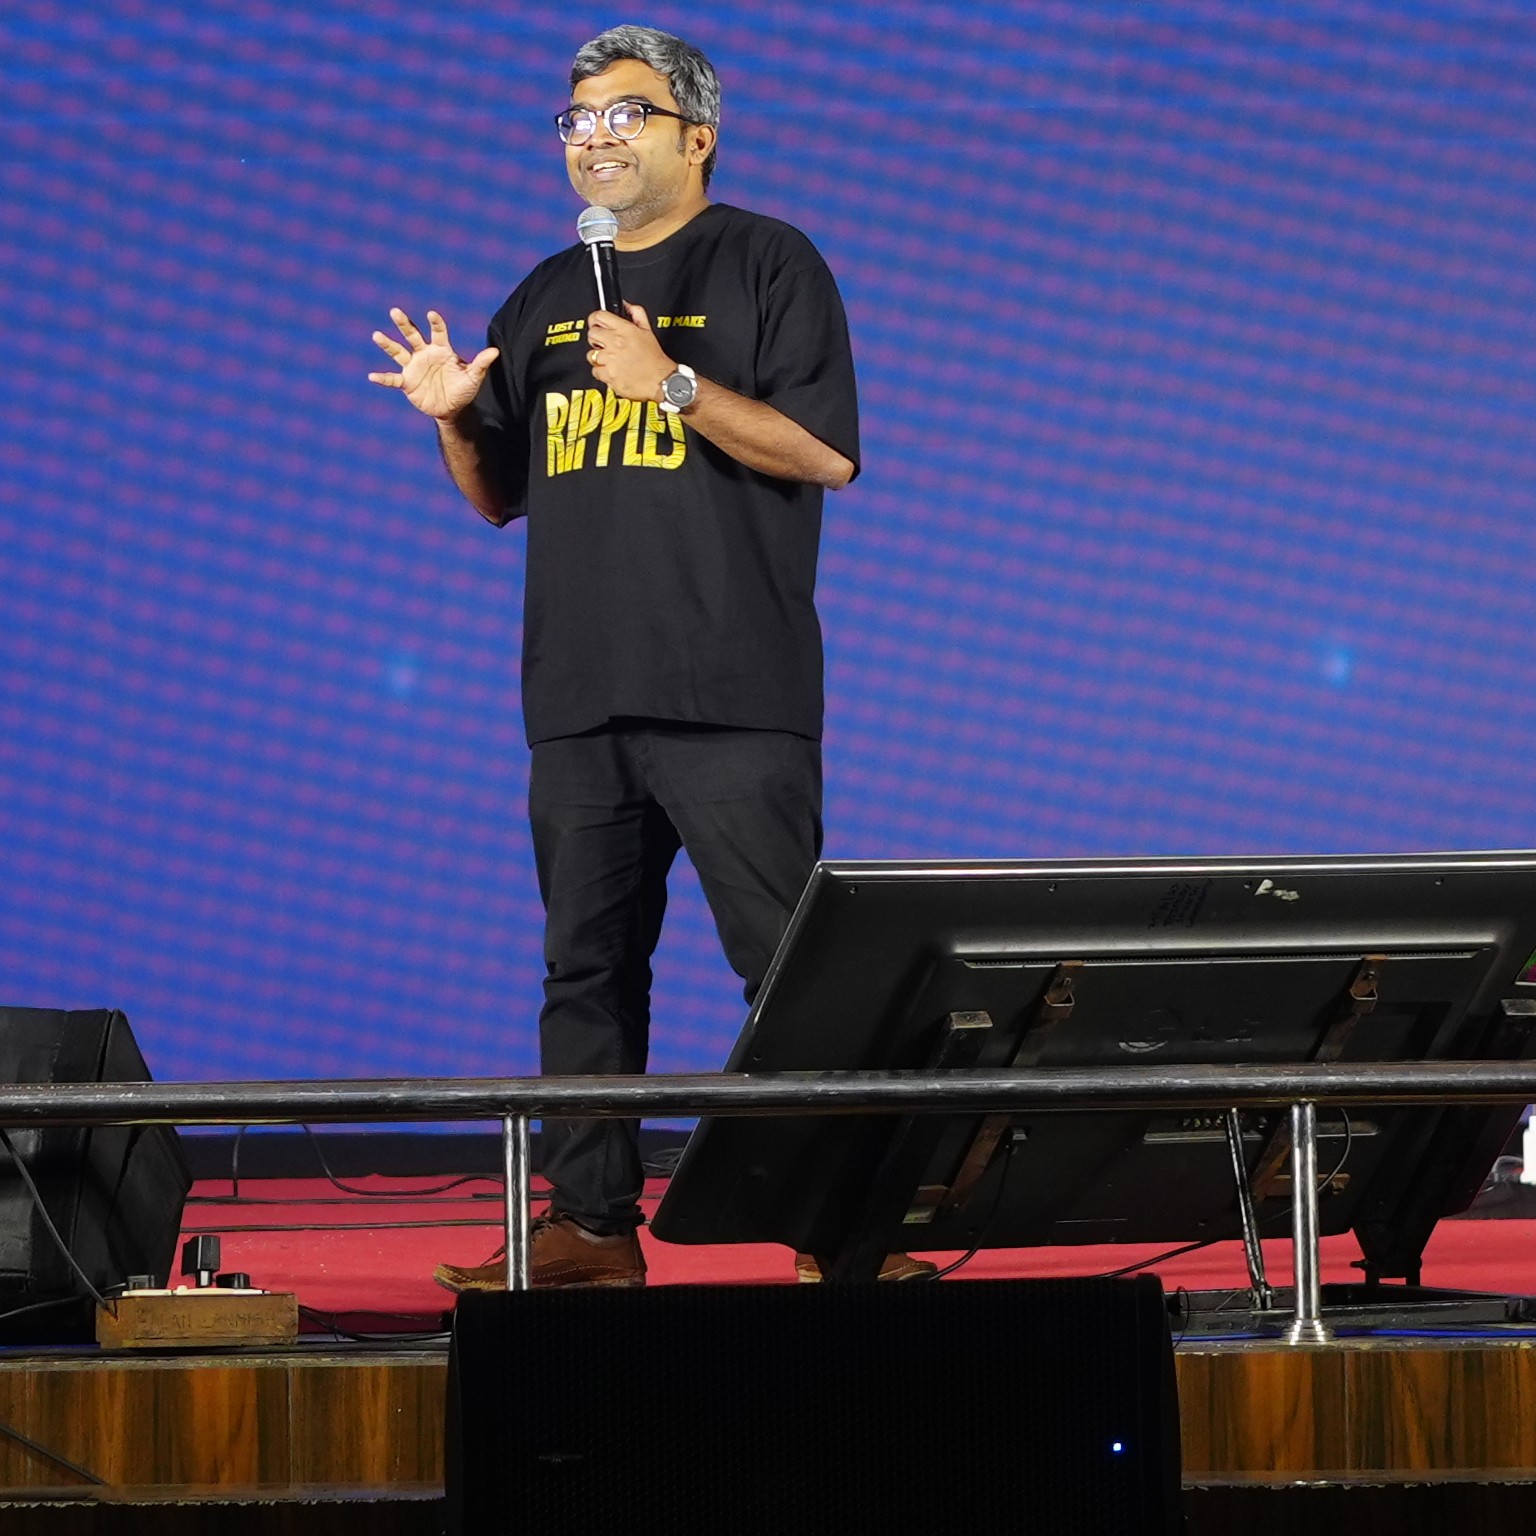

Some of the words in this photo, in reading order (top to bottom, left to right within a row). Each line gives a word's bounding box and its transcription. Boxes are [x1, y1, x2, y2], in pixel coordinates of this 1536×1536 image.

[547, 321, 575, 334] LOST
[657, 316, 672, 328] TO
[672, 315, 707, 328] MAKE
[544, 332, 581, 346] FOUND
